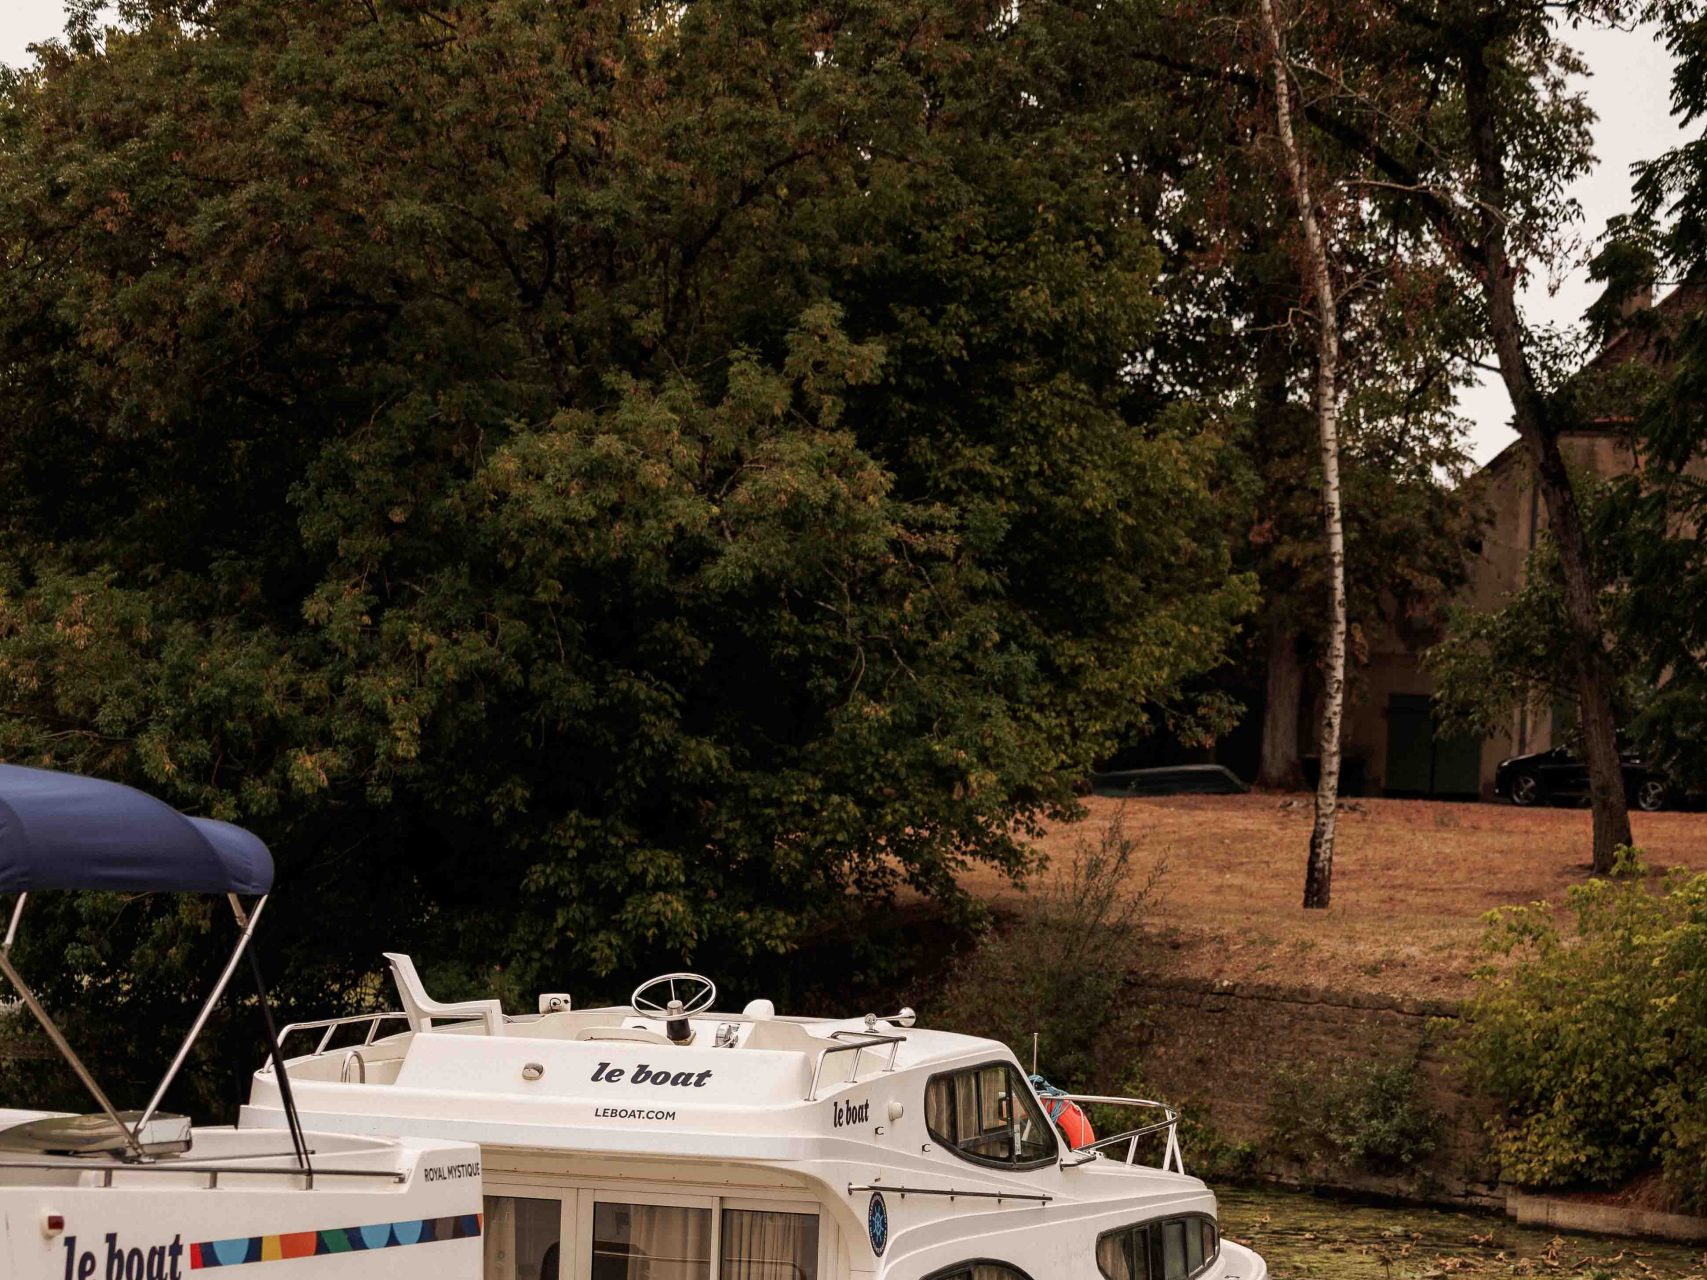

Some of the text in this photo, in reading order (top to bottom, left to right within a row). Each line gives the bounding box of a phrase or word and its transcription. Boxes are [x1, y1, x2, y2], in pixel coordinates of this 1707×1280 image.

[590, 1062, 713, 1088] le boat
[594, 1107, 676, 1121] LEBOAT.COM
[833, 1098, 870, 1128] le boat
[424, 1162, 480, 1182] ROYAL MYSTIQUE
